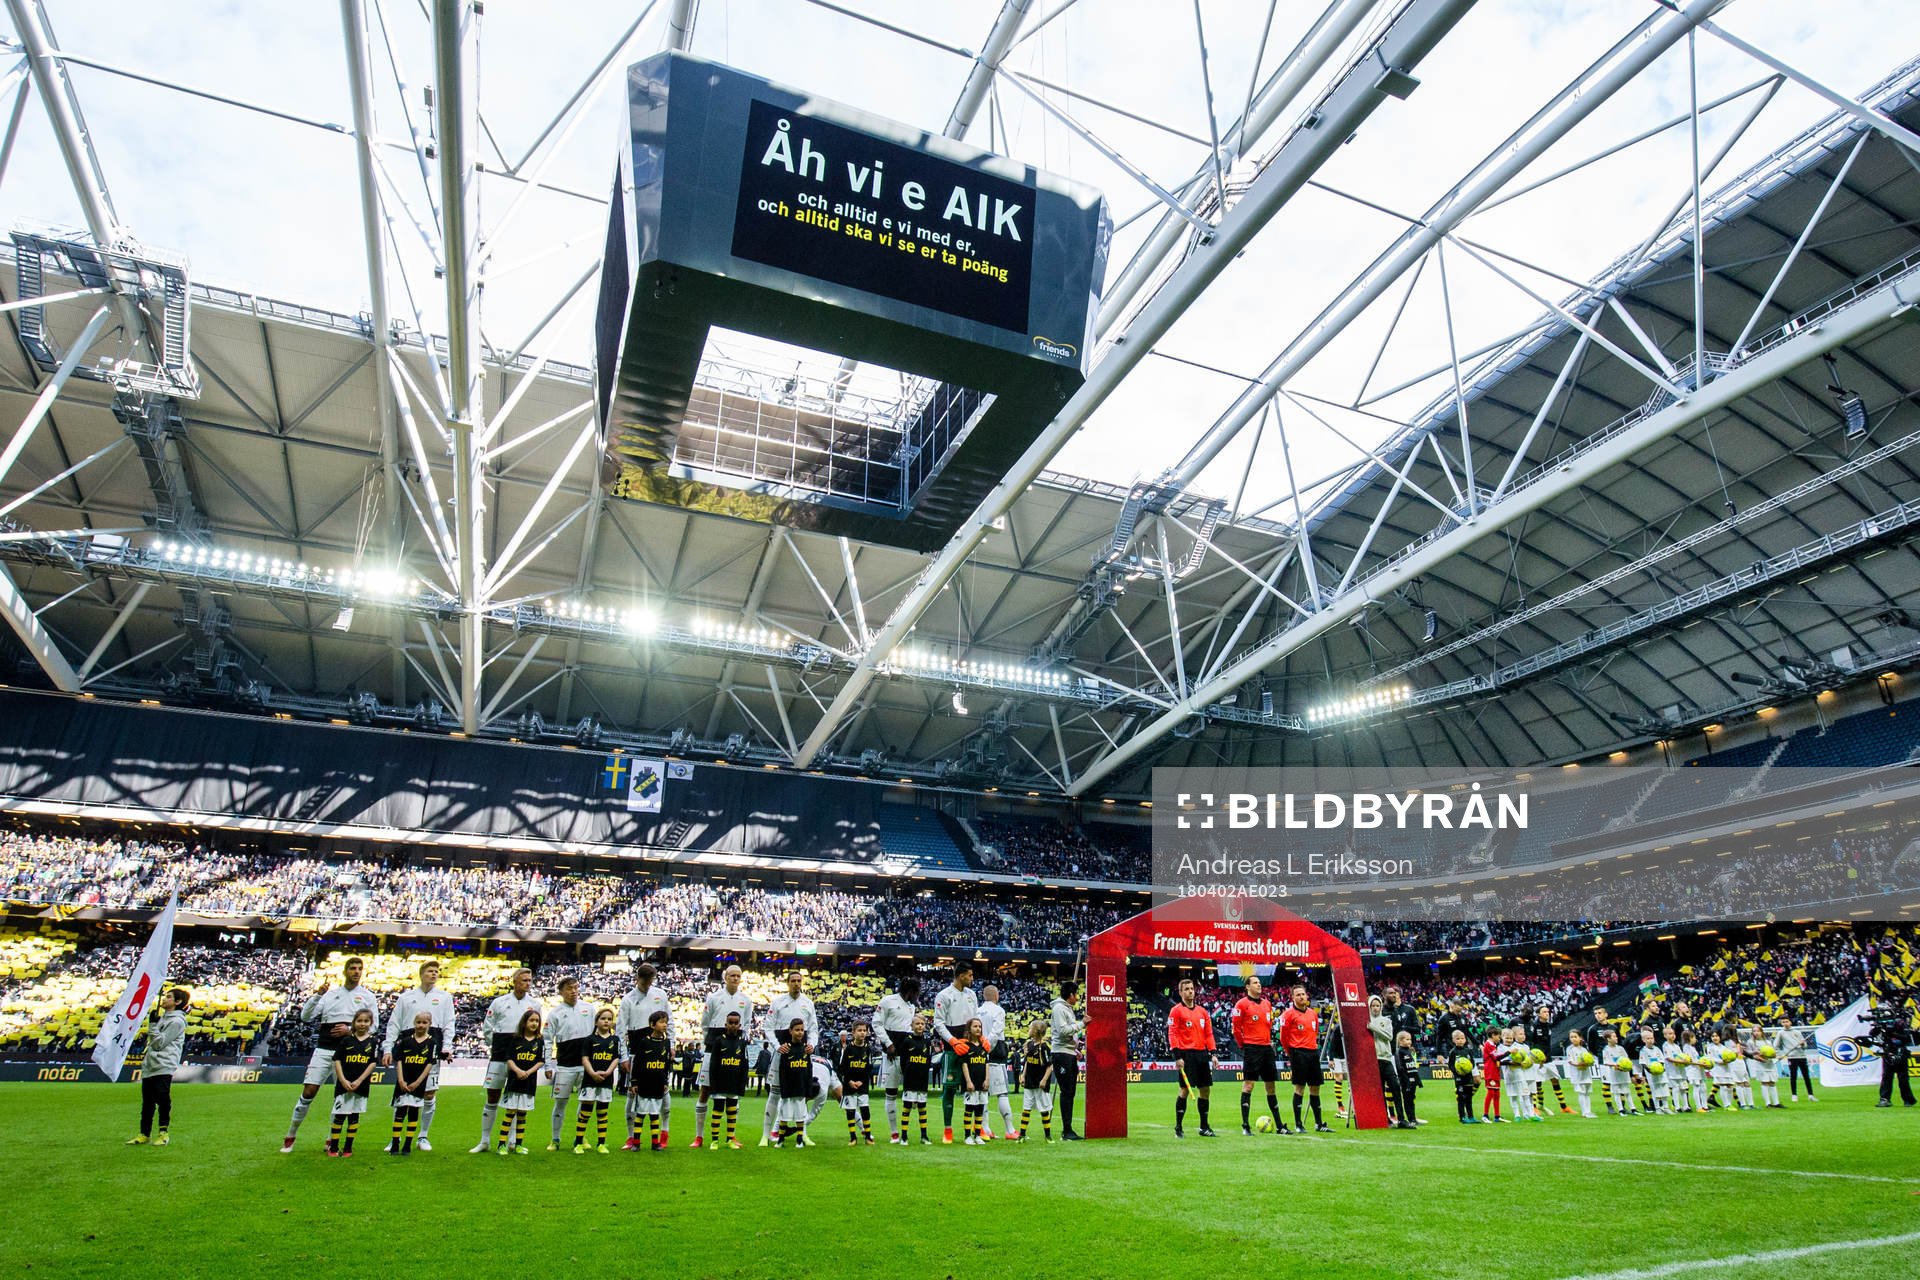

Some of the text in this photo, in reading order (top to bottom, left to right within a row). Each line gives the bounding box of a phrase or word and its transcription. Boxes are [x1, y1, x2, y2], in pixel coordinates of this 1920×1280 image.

[761, 118, 1022, 242] Åh vi e AIK
[797, 192, 976, 255] och alltid e vi med er,
[757, 199, 1009, 283] och alltid ska vi se er ta poäng
[1039, 341, 1070, 357] friends
[1213, 922, 1239, 930] SVENSKA
[1154, 932, 1309, 958] Framåt för svensk fotboll!
[346, 1053, 370, 1063] notar
[405, 1054, 427, 1064] notar
[517, 1052, 536, 1062] notar
[593, 1051, 613, 1061] notar
[910, 1055, 927, 1064] notar
[970, 1055, 986, 1064] notar
[646, 1059, 665, 1069] notar
[721, 1057, 740, 1067] notar
[790, 1059, 808, 1068] notar
[850, 1060, 867, 1069] notar
[37, 1065, 84, 1080] notar
[221, 1067, 263, 1082] notar
